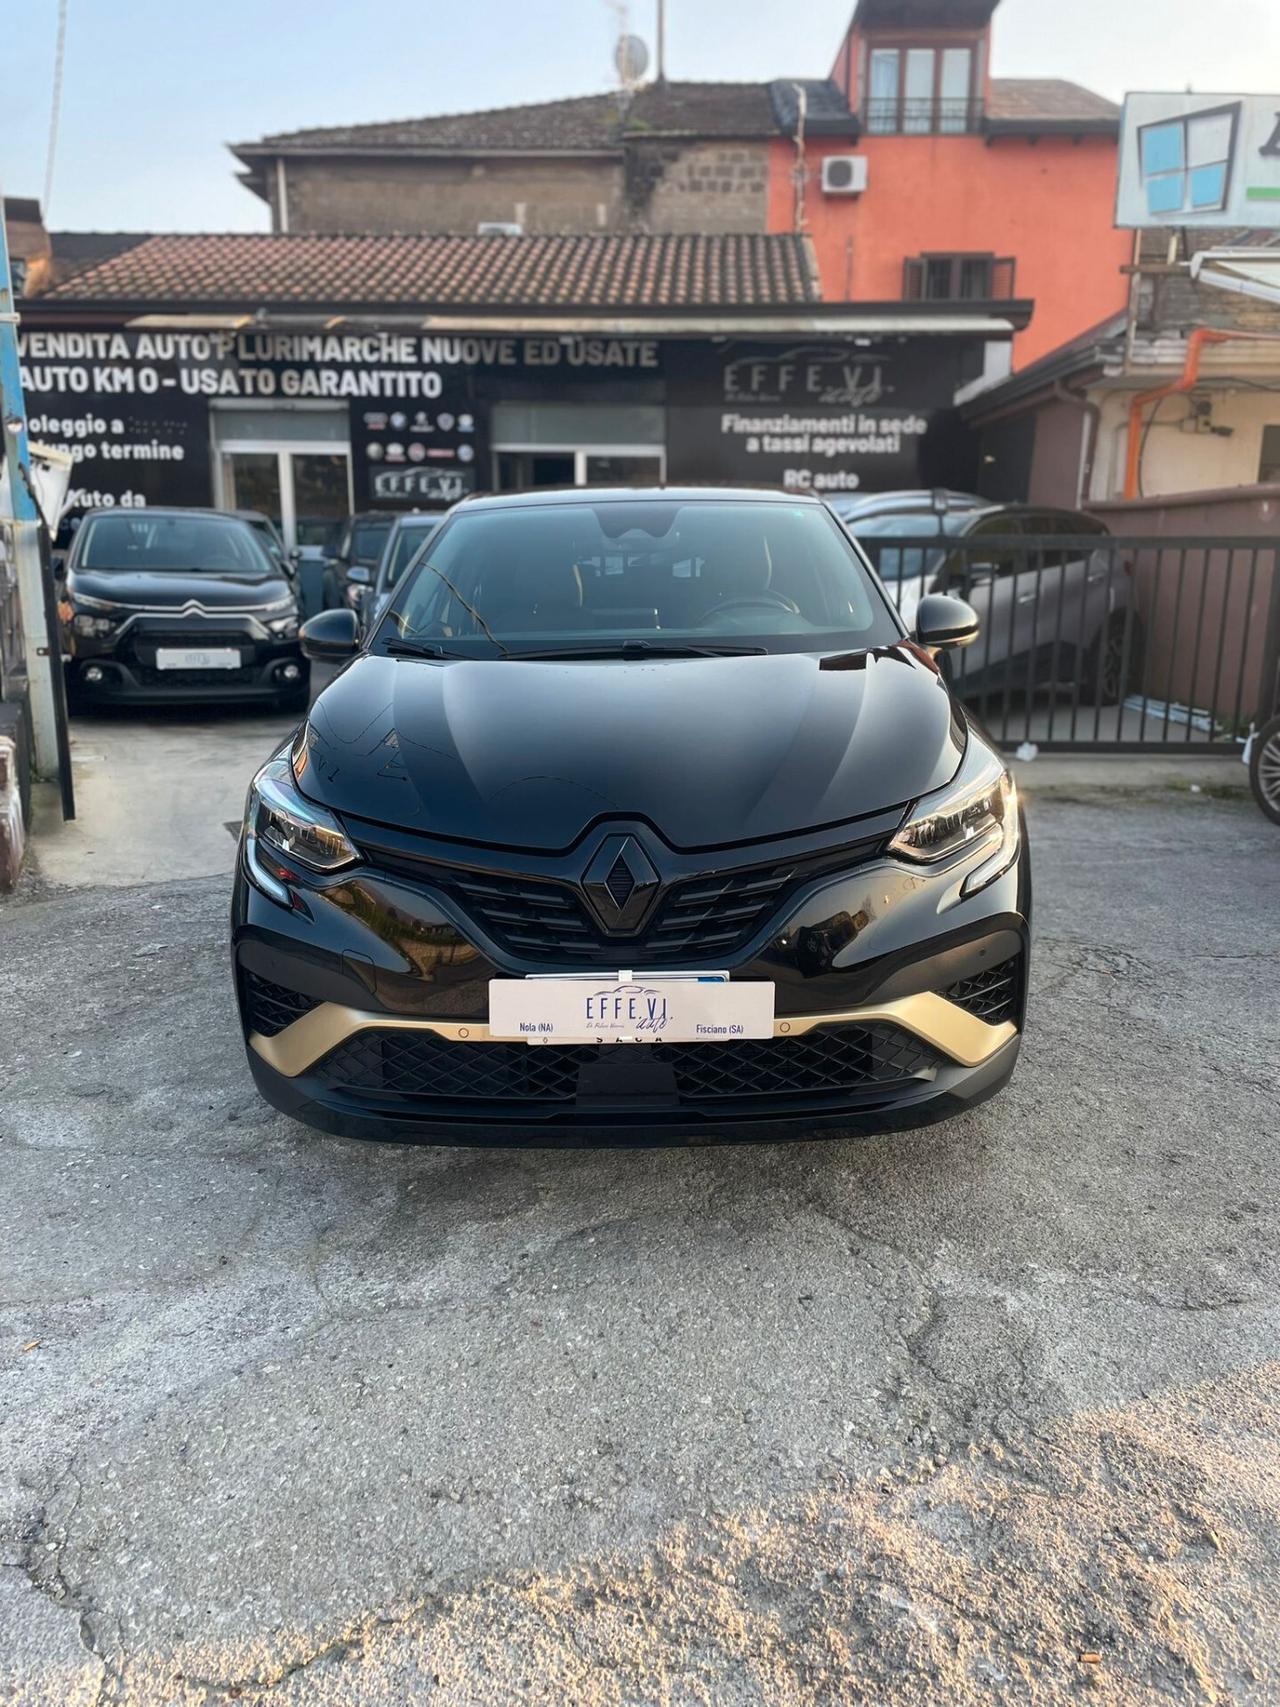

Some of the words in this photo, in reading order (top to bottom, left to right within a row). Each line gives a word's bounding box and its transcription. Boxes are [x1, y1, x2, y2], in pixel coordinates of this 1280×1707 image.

[18, 333, 130, 360] VENDITA
[135, 335, 211, 360] AUTO
[214, 335, 417, 363] PLURIMARCHE
[422, 338, 516, 365] NUOVE
[524, 341, 561, 365] ED
[567, 341, 658, 367] USATE
[20, 366, 89, 393] AUTO
[94, 367, 134, 393] KM
[180, 369, 275, 395] USATO
[281, 370, 442, 398] GARANTITO
[28, 413, 107, 438] oleggio
[111, 418, 125, 434] a
[721, 413, 856, 434] Finanziamenti
[858, 414, 877, 433] in
[880, 415, 927, 435] sede
[100, 438, 185, 461] termine
[746, 437, 760, 452] a
[762, 435, 810, 453] tassi
[812, 434, 901, 457] agevolati
[783, 469, 811, 488] RC
[813, 470, 859, 489] auto
[120, 490, 147, 508] da
[519, 1022, 536, 1032] Nola
[538, 1022, 554, 1033] (NA)
[696, 1024, 727, 1034] Fisciano
[729, 1024, 744, 1035] (SA)
